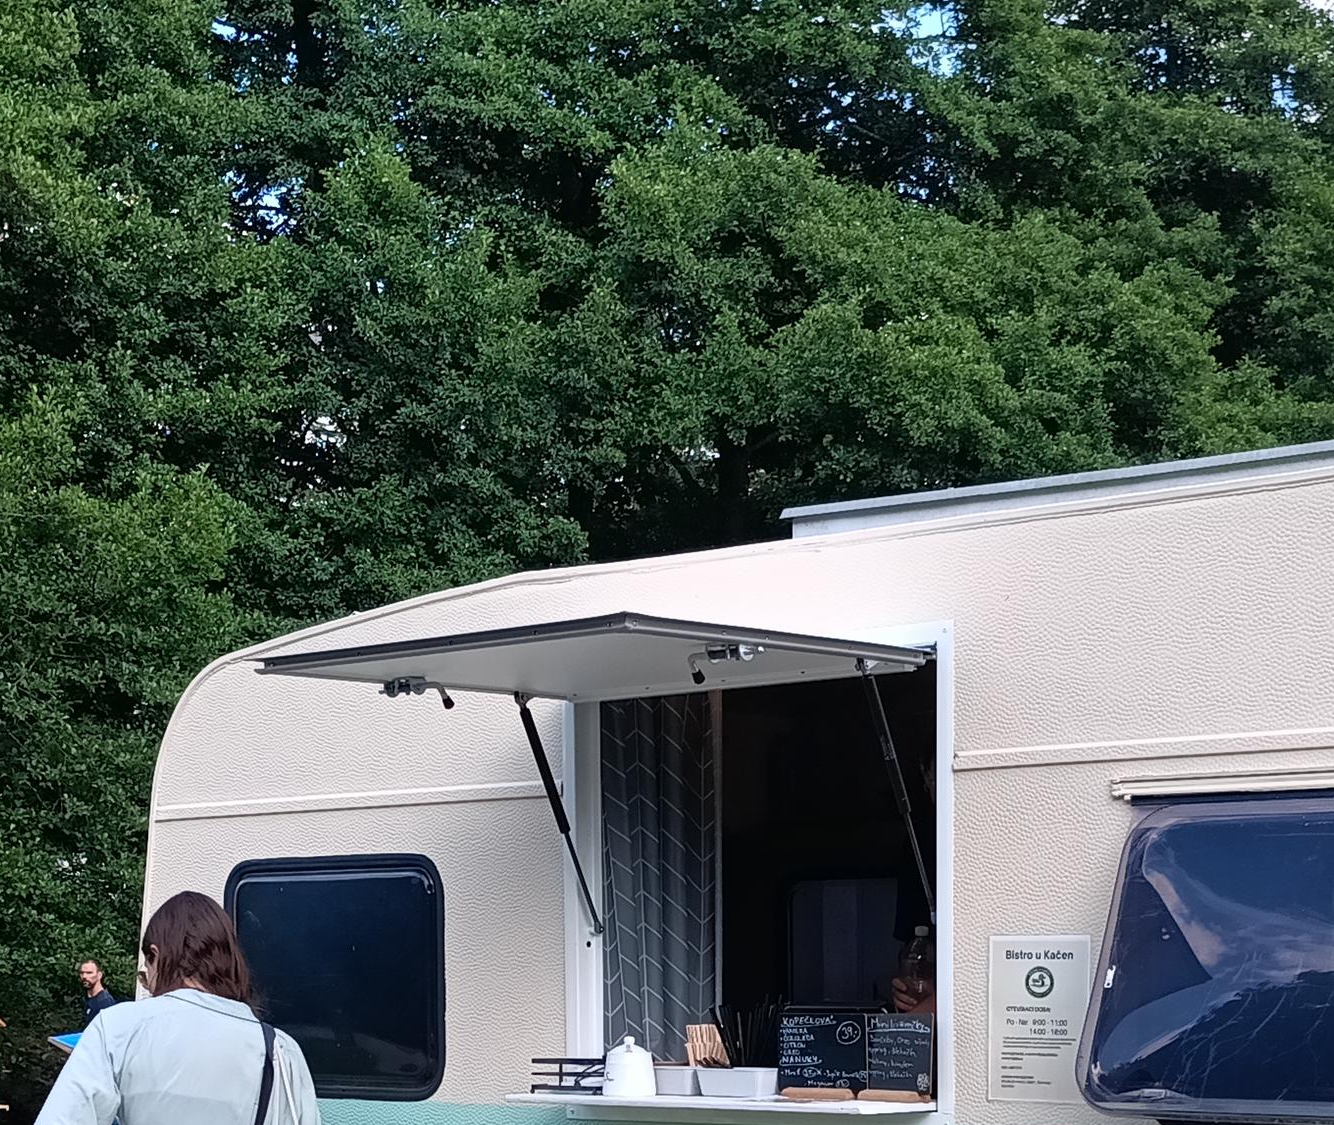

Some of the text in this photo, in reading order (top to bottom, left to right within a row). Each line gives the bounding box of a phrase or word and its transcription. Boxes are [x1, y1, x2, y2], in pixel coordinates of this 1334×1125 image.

[1005, 950, 1074, 960] Bistro u Kačen
[782, 1055, 818, 1063] NANUKY
